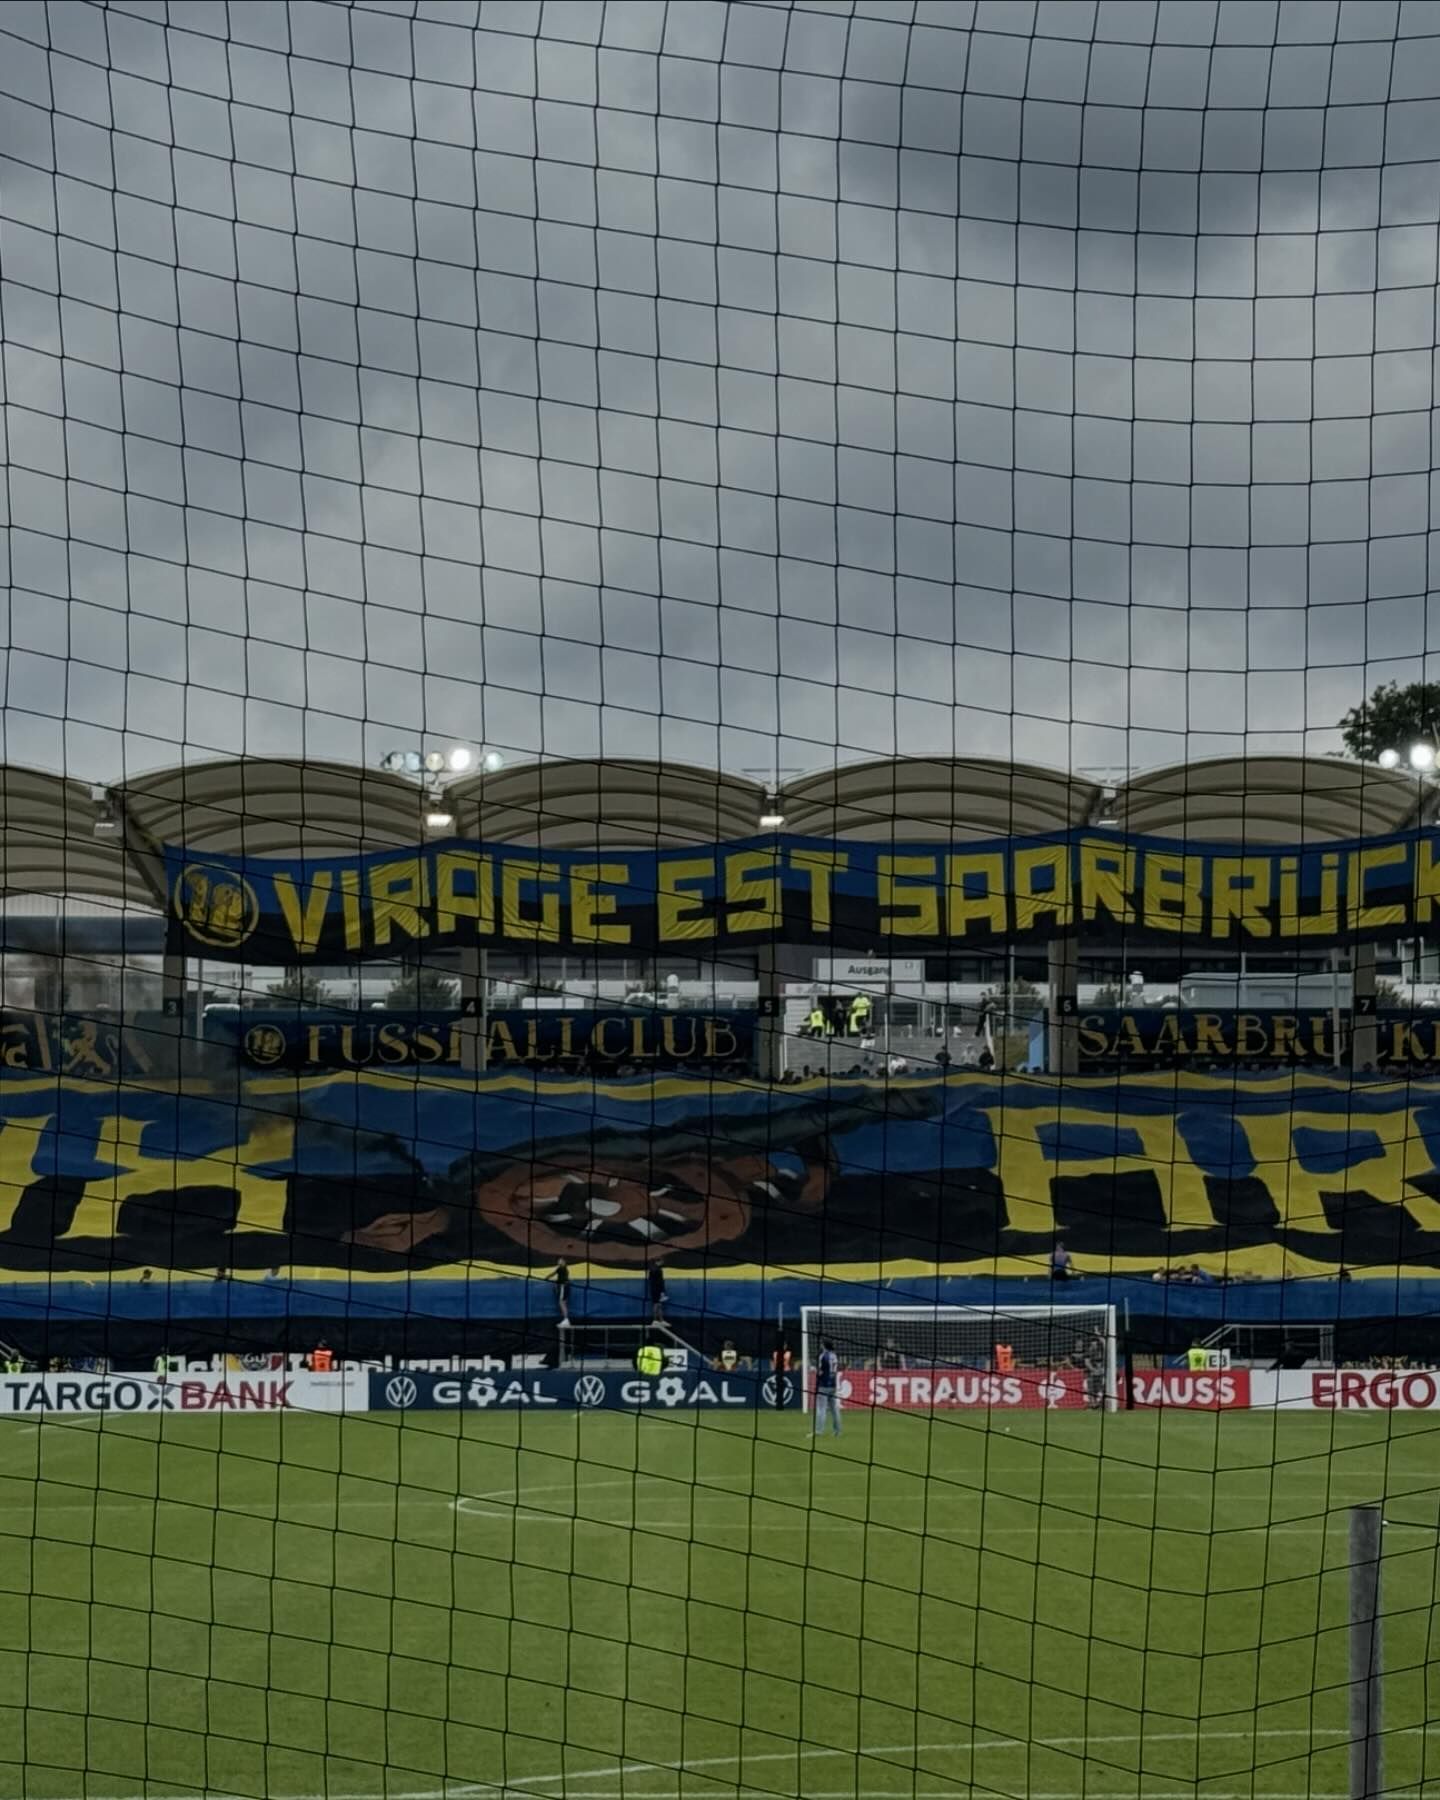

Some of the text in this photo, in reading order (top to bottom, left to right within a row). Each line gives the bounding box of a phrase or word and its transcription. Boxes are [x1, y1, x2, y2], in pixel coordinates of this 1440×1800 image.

[273, 850, 631, 953] VIRAGE
[657, 847, 848, 941] EST
[869, 1376, 1022, 1405] STRAUSS
[1084, 1376, 1236, 1405] RAUSS
[1312, 1373, 1436, 1408] ERGO
